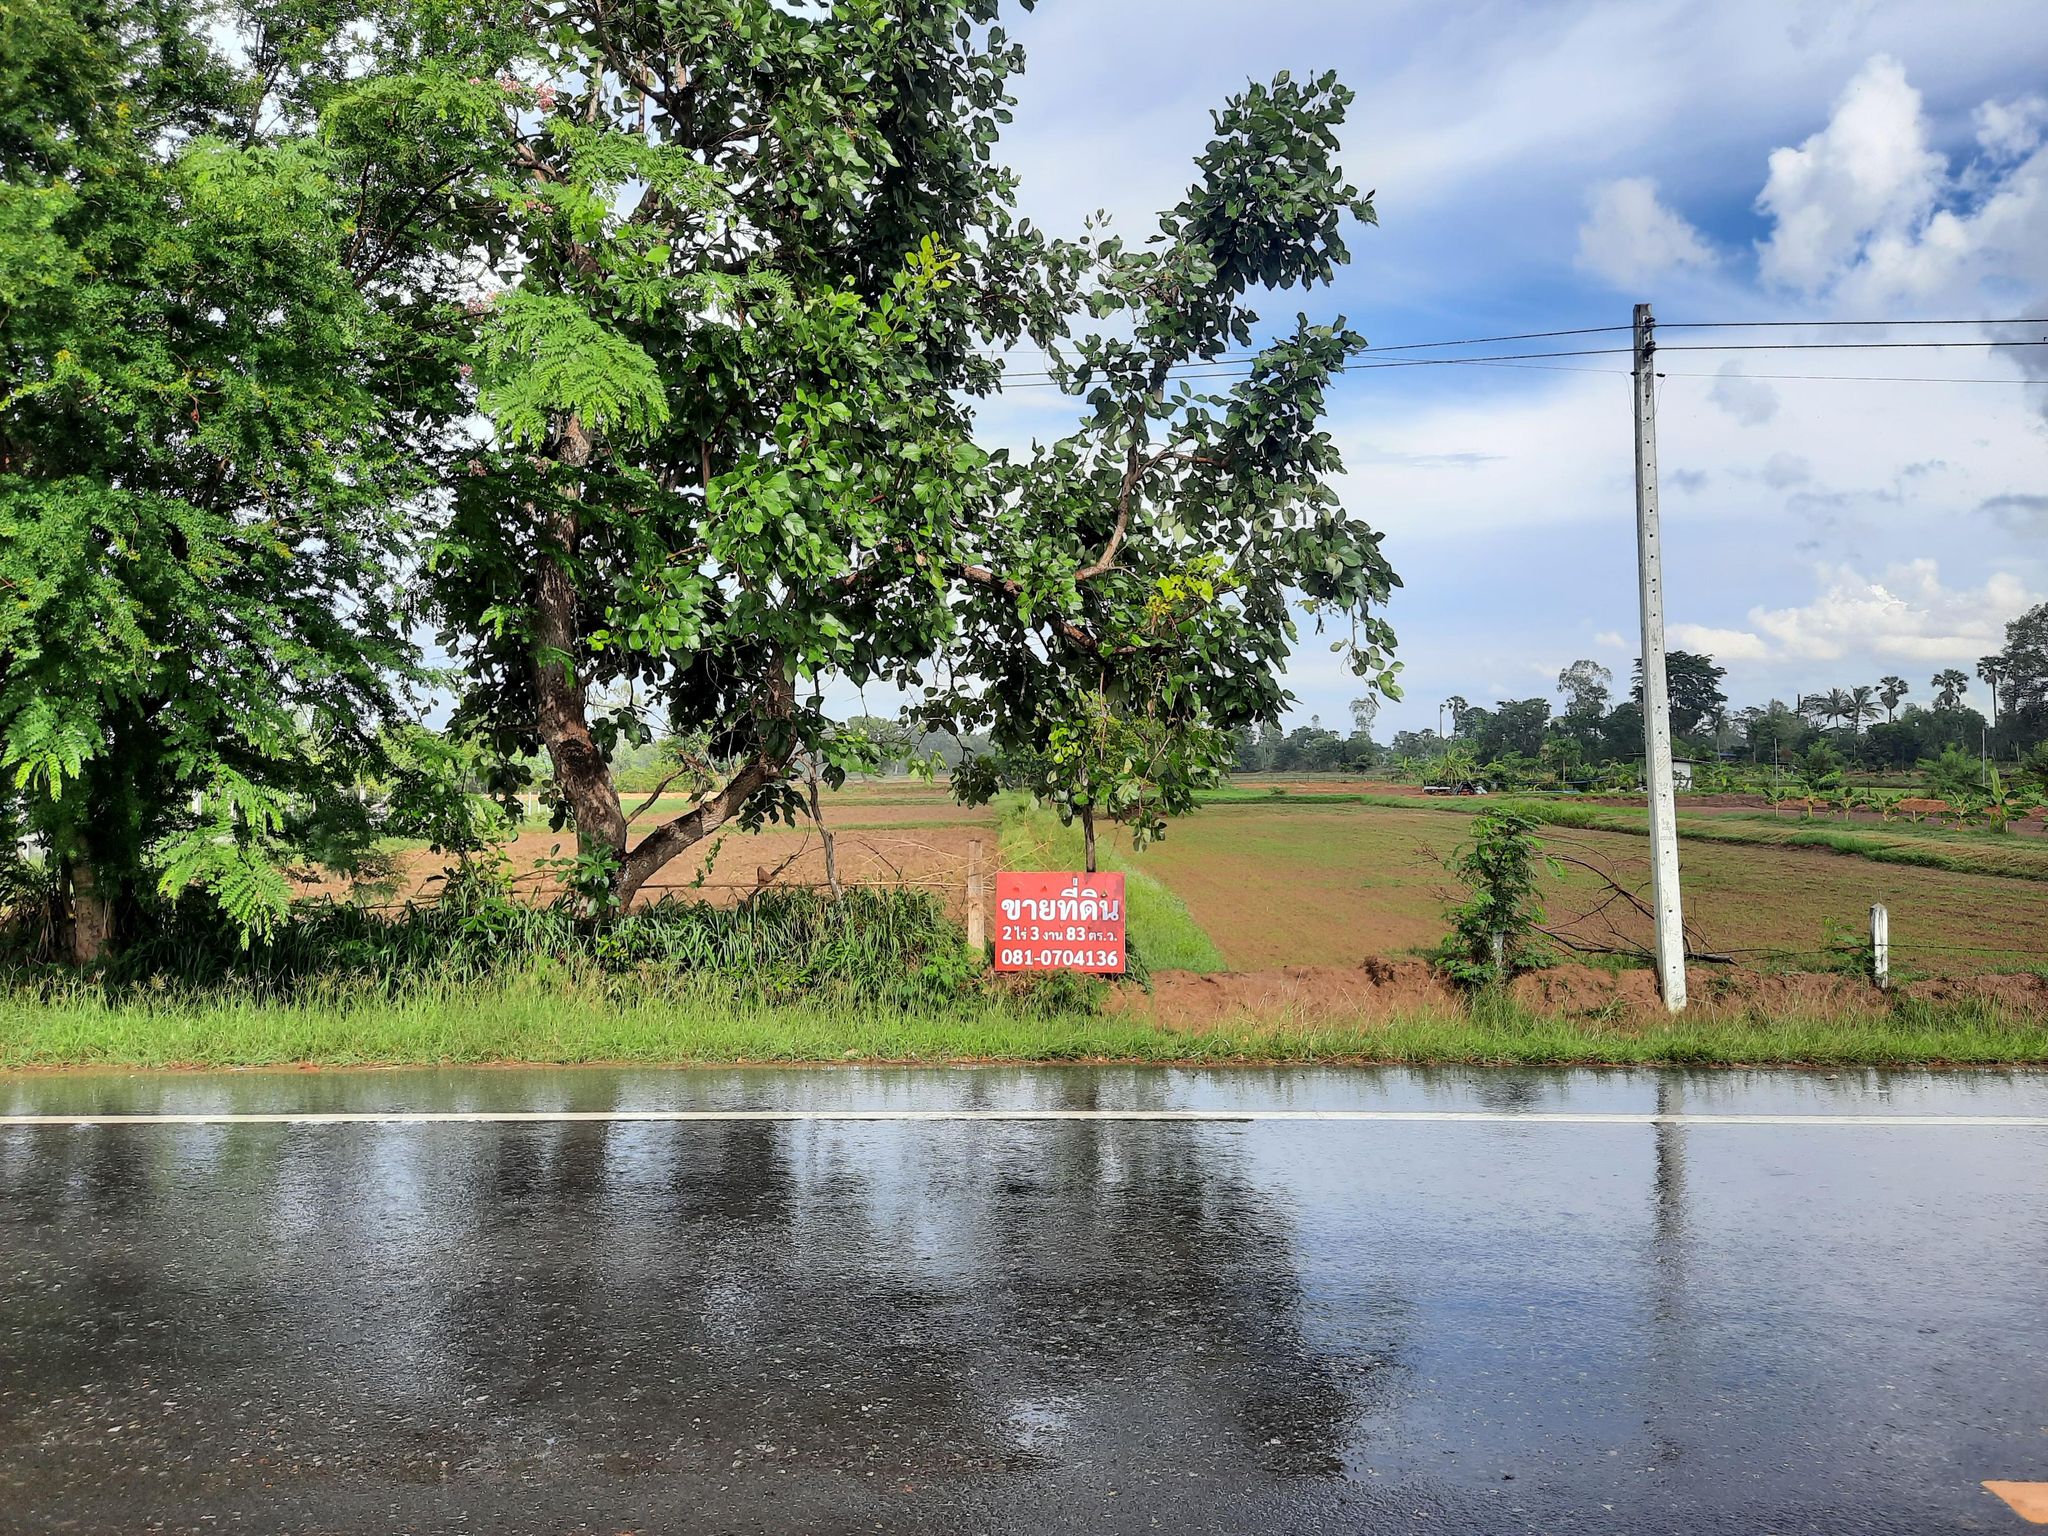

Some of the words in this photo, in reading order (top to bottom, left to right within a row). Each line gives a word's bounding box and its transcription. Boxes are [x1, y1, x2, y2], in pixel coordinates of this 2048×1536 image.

[1001, 877, 1119, 921] ขายที่ดิน
[1002, 926, 1012, 940] 2
[1014, 926, 1027, 940] ไร่
[1030, 926, 1039, 940] 3
[1042, 931, 1063, 941] งาน
[1066, 926, 1086, 940] 83
[1001, 949, 1118, 966] 081-0704136
